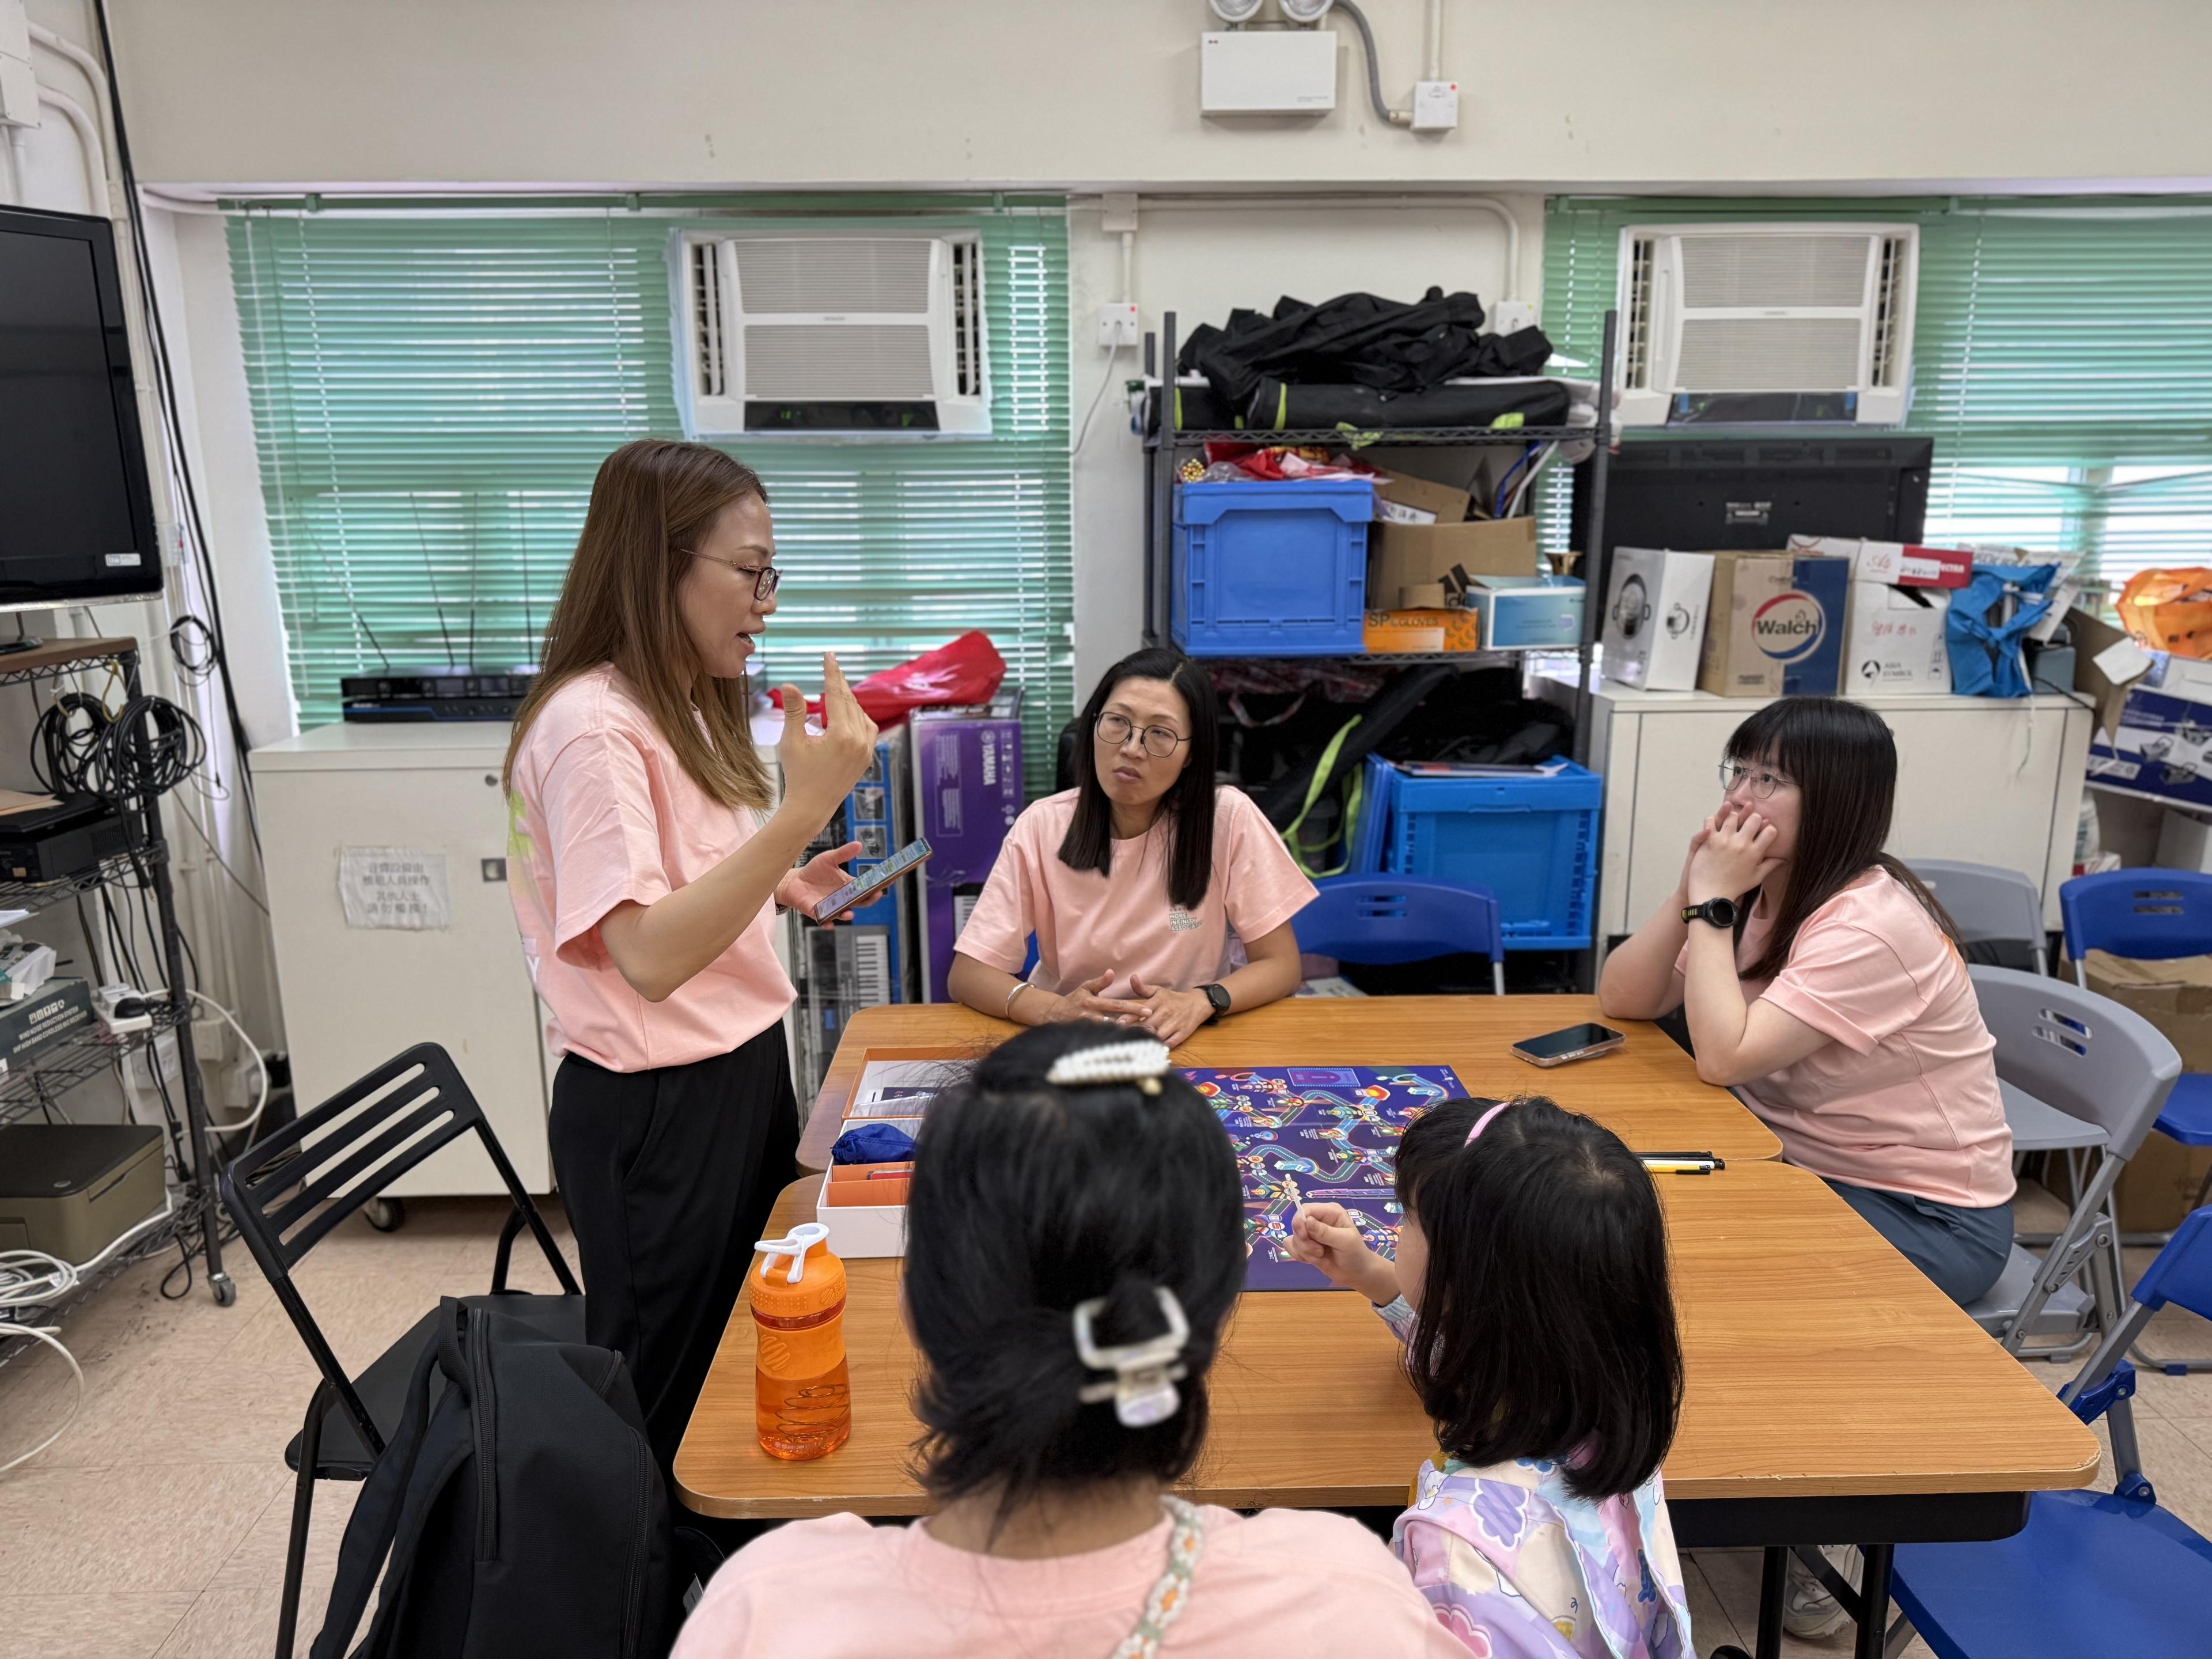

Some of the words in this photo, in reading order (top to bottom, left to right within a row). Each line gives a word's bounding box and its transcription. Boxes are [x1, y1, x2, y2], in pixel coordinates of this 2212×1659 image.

[1399, 617, 1438, 627] GLOVES
[1758, 620, 1817, 635] Walch
[982, 743, 997, 786] YAMAHA
[1171, 918, 1196, 926] INFINITY
[13, 1045, 22, 1054] VHF
[21, 1040, 32, 1050] HIGH
[31, 1035, 43, 1044] BAND
[42, 1023, 63, 1039] CORDLESS
[70, 1010, 87, 1023] RECEIVER
[18, 1030, 30, 1040] WIND
[30, 1024, 43, 1035] NOISE
[42, 1013, 65, 1028] REDUCTION
[63, 1006, 79, 1017] SYSTEM
